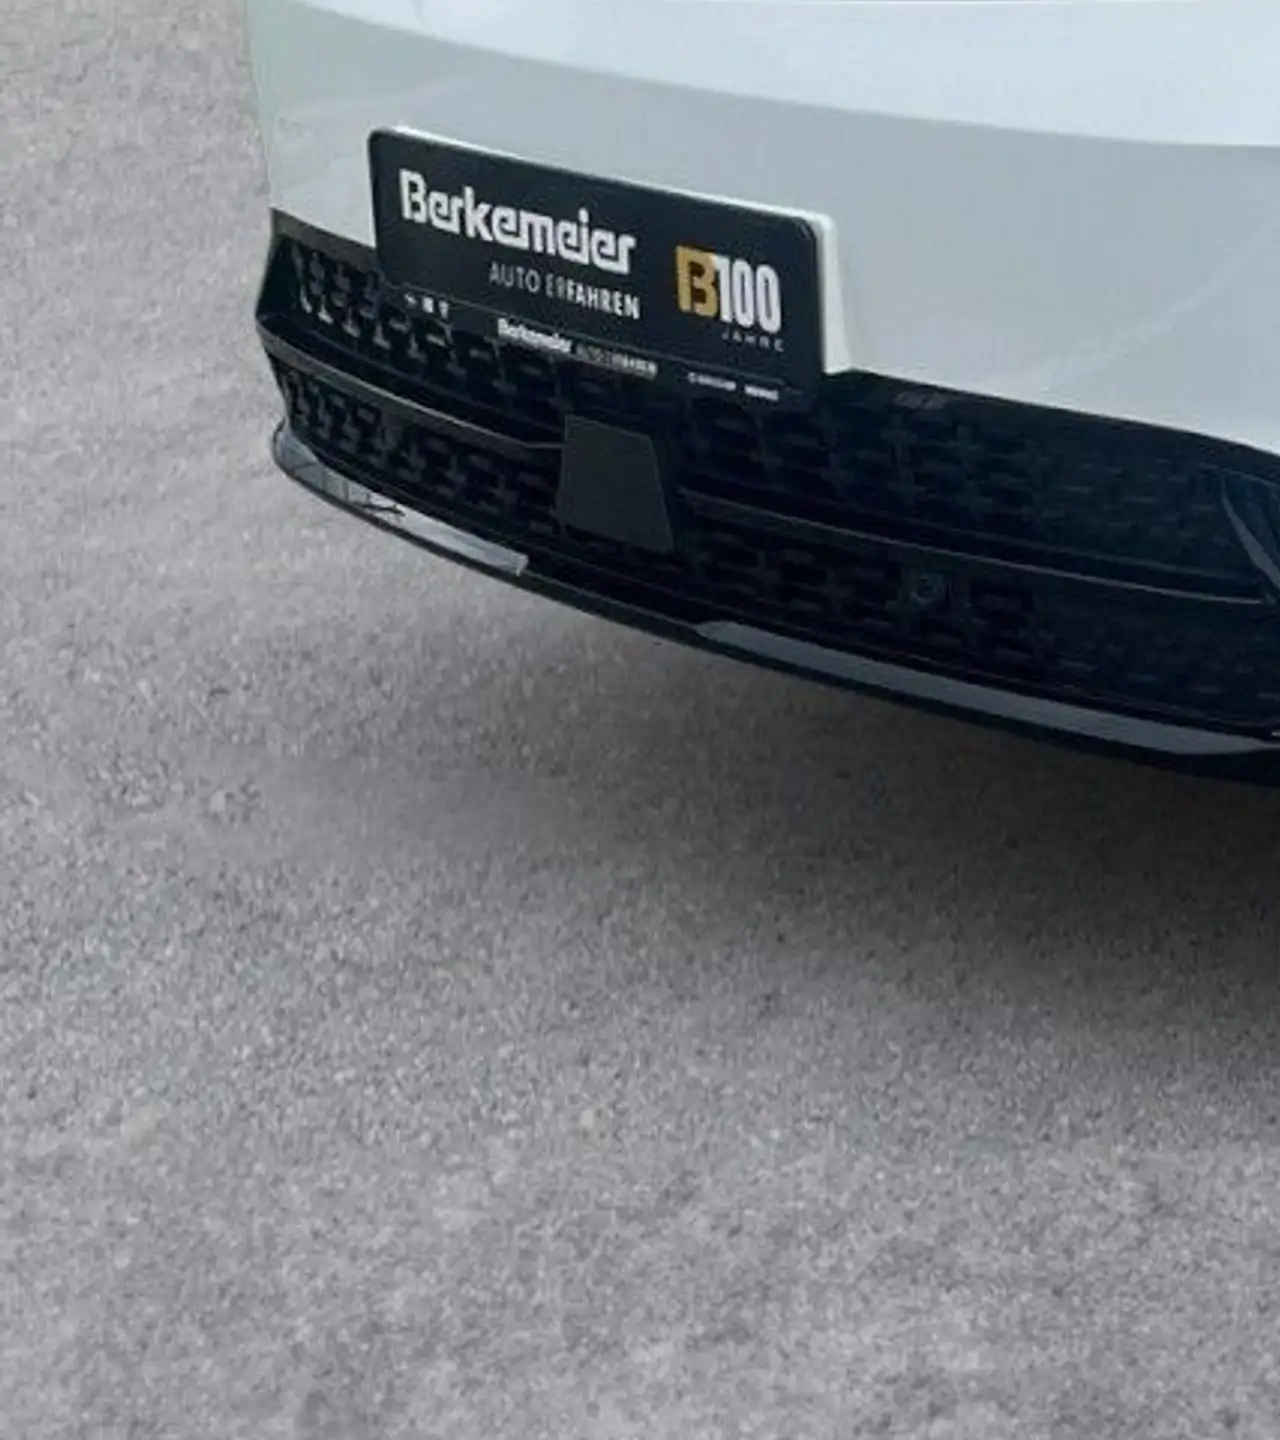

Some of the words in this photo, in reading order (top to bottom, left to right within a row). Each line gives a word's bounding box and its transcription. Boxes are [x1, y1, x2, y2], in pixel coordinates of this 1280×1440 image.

[399, 168, 636, 275] Berkemeier
[489, 261, 540, 294] AUTO
[545, 273, 641, 320] ERFAHREN
